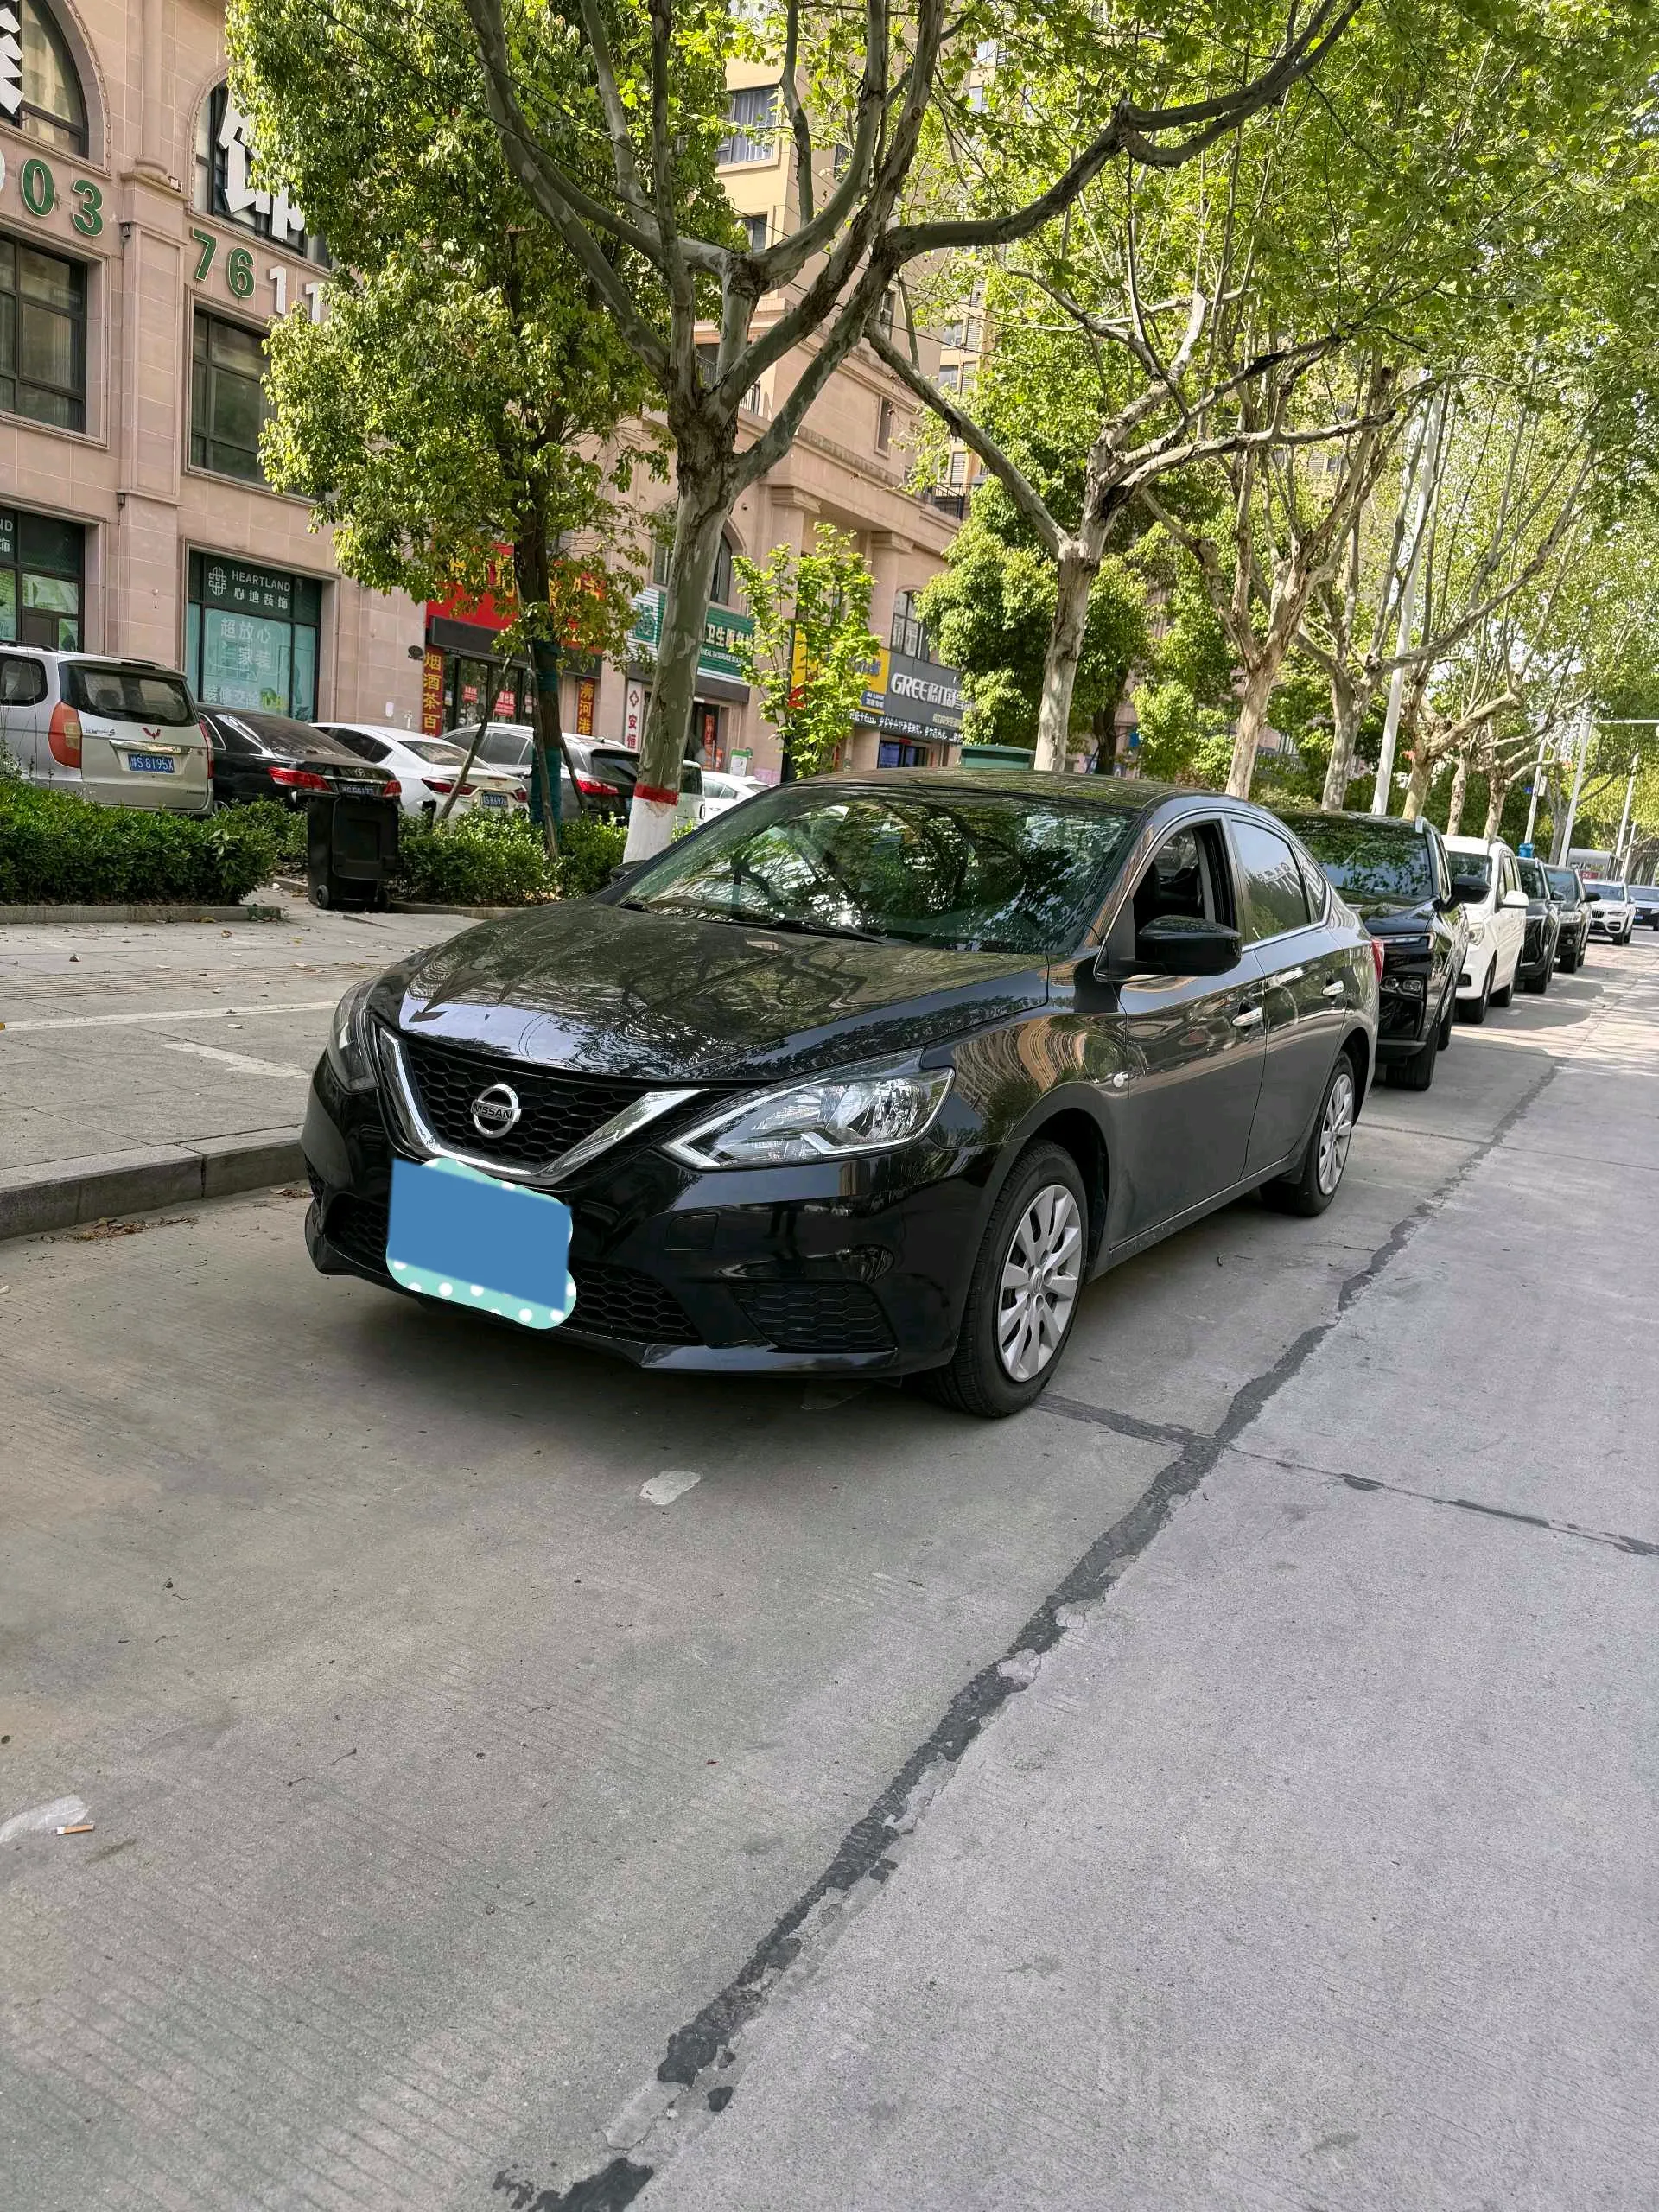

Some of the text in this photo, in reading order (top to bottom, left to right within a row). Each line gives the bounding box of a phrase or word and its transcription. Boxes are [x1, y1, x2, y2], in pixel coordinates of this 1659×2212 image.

[0, 149, 104, 237] 03
[232, 570, 291, 592] HEARTLAND
[234, 588, 289, 609] 心地装饰
[422, 652, 442, 737] 烟酒茶百
[472, 1104, 513, 1119] NISSAN
